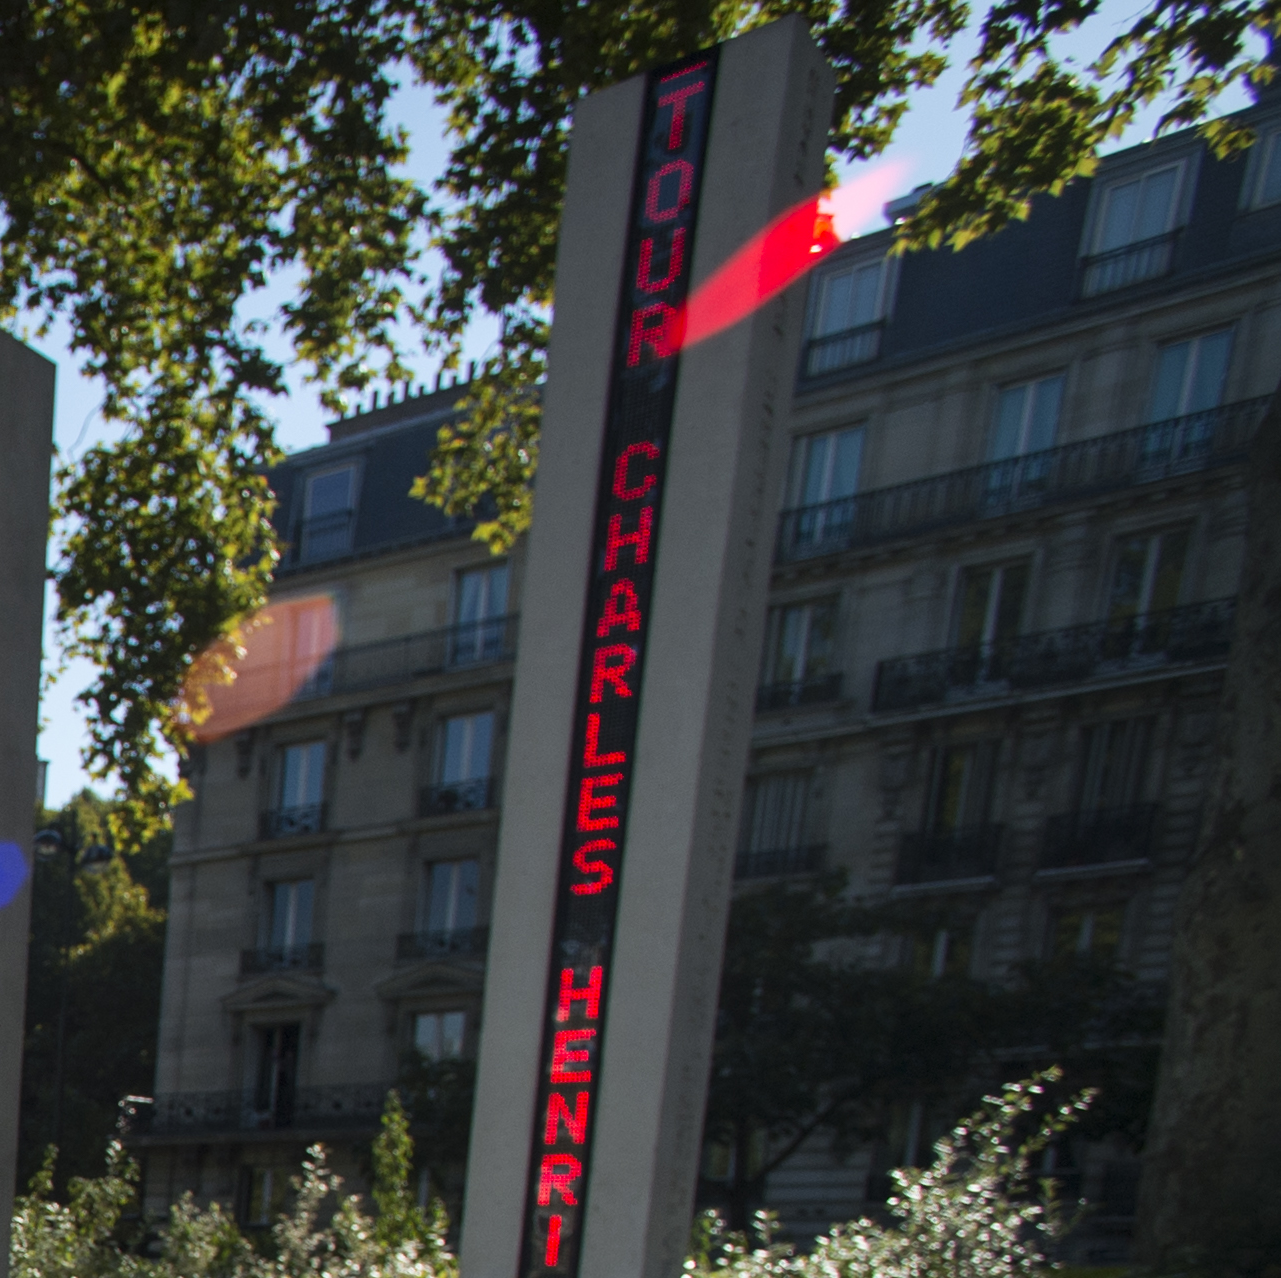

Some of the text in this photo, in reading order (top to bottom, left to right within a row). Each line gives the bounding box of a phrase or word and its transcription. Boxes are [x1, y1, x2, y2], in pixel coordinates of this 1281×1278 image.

[627, 61, 709, 368] TOUR
[570, 440, 660, 896] CHARLES
[536, 965, 603, 1267] HENRI
